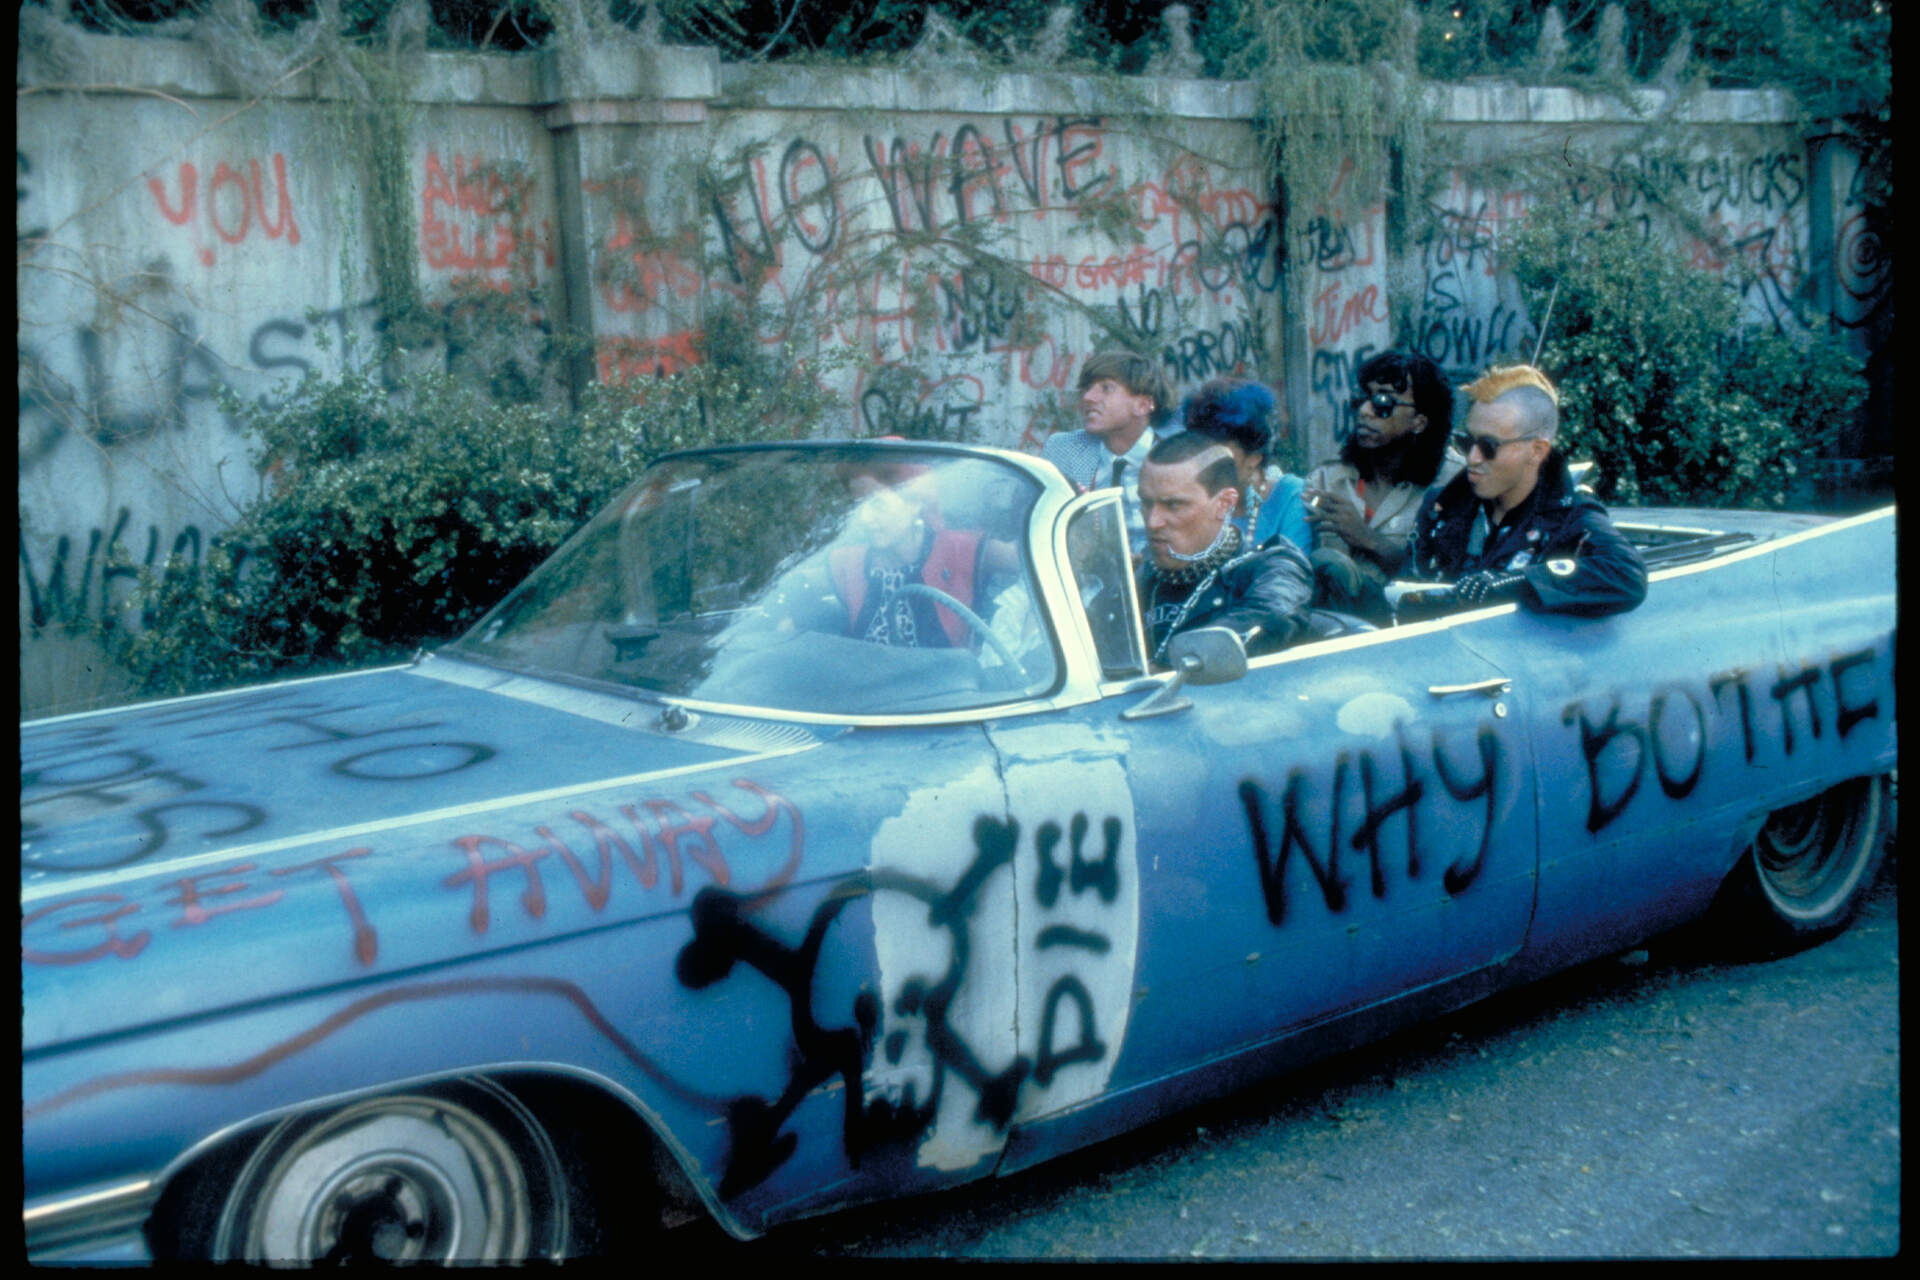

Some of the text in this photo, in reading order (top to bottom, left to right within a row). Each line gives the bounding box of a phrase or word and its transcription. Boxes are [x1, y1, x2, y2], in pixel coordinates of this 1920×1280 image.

[148, 152, 300, 266] YOU
[700, 136, 846, 285] NO
[862, 112, 1114, 236] WAVE
[20, 776, 804, 968] GET AWAY
[1237, 715, 1499, 926] WHY
